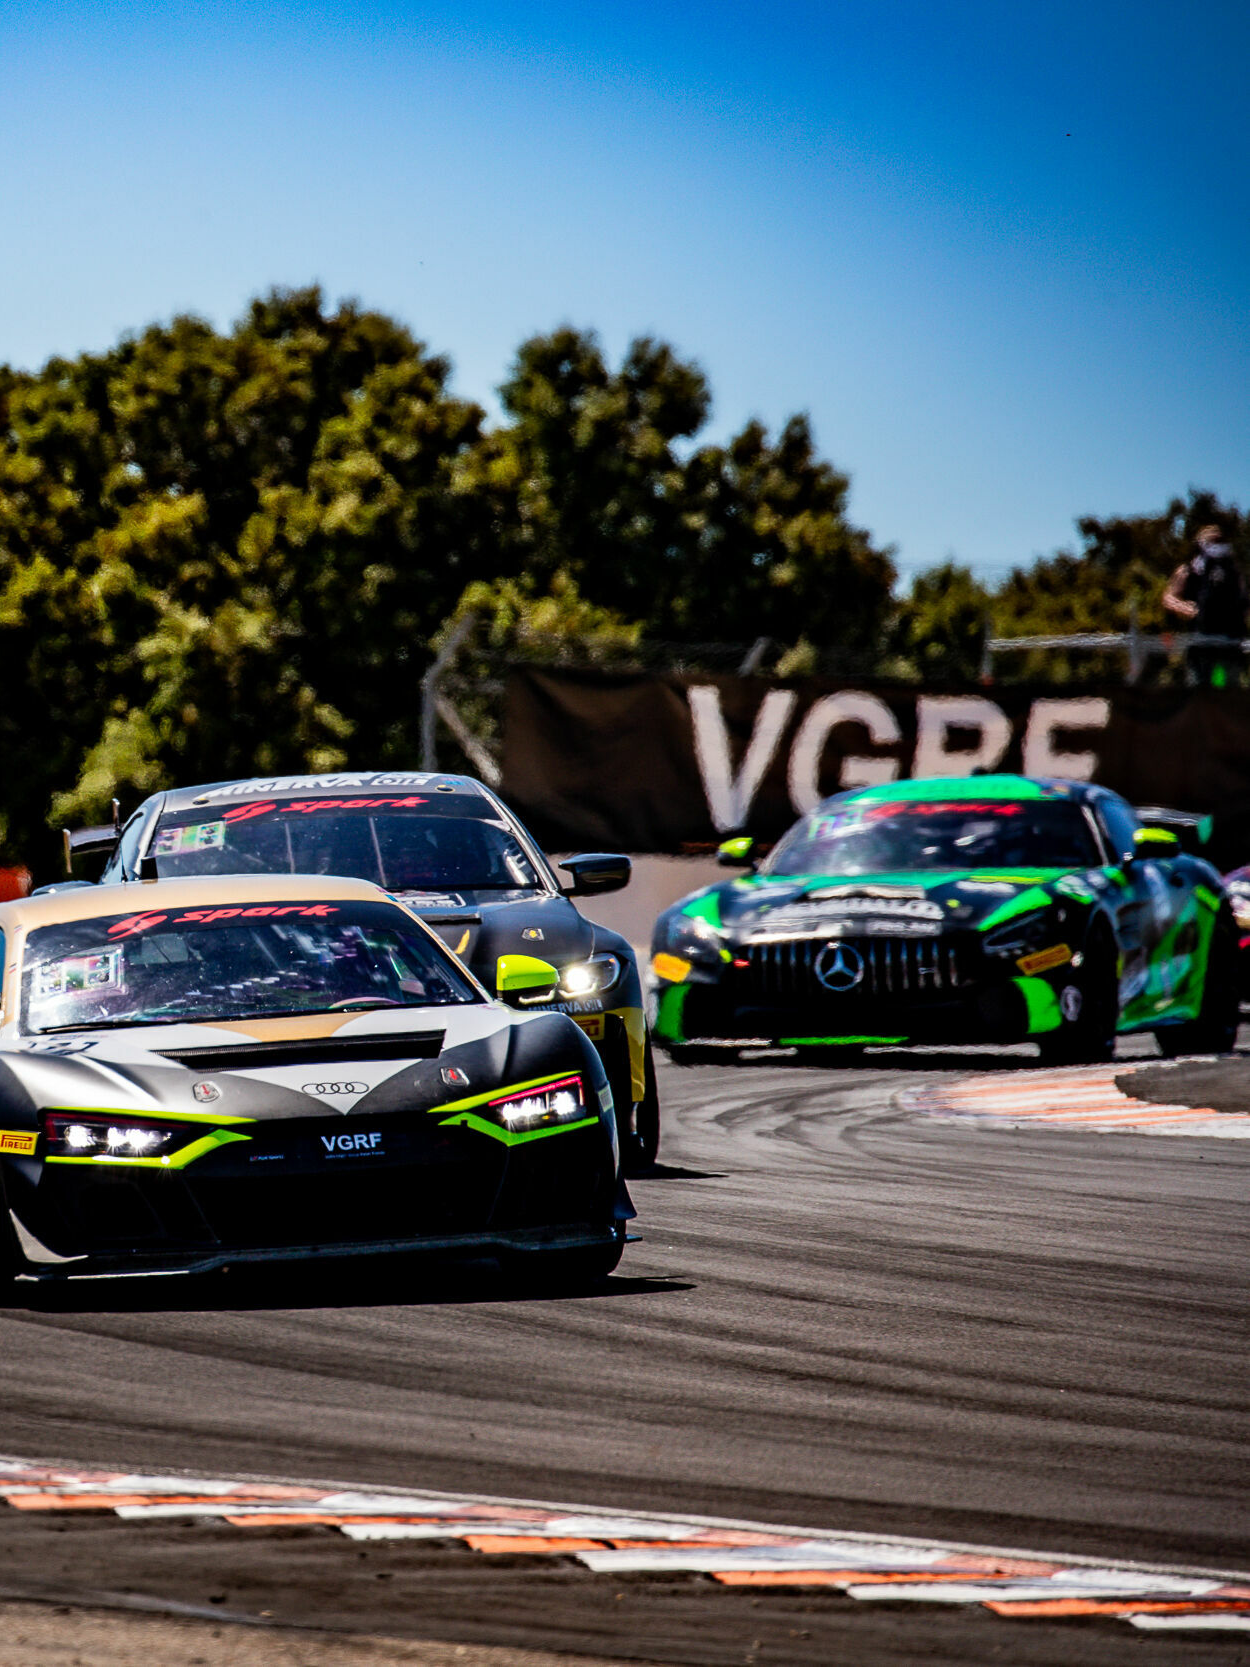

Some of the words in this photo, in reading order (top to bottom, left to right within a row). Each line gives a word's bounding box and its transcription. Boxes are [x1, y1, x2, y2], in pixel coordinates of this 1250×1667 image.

[280, 796, 429, 814] spark
[173, 905, 340, 924] spark
[1, 1135, 34, 1150] PIRELLI
[321, 1132, 382, 1152] VGRF
